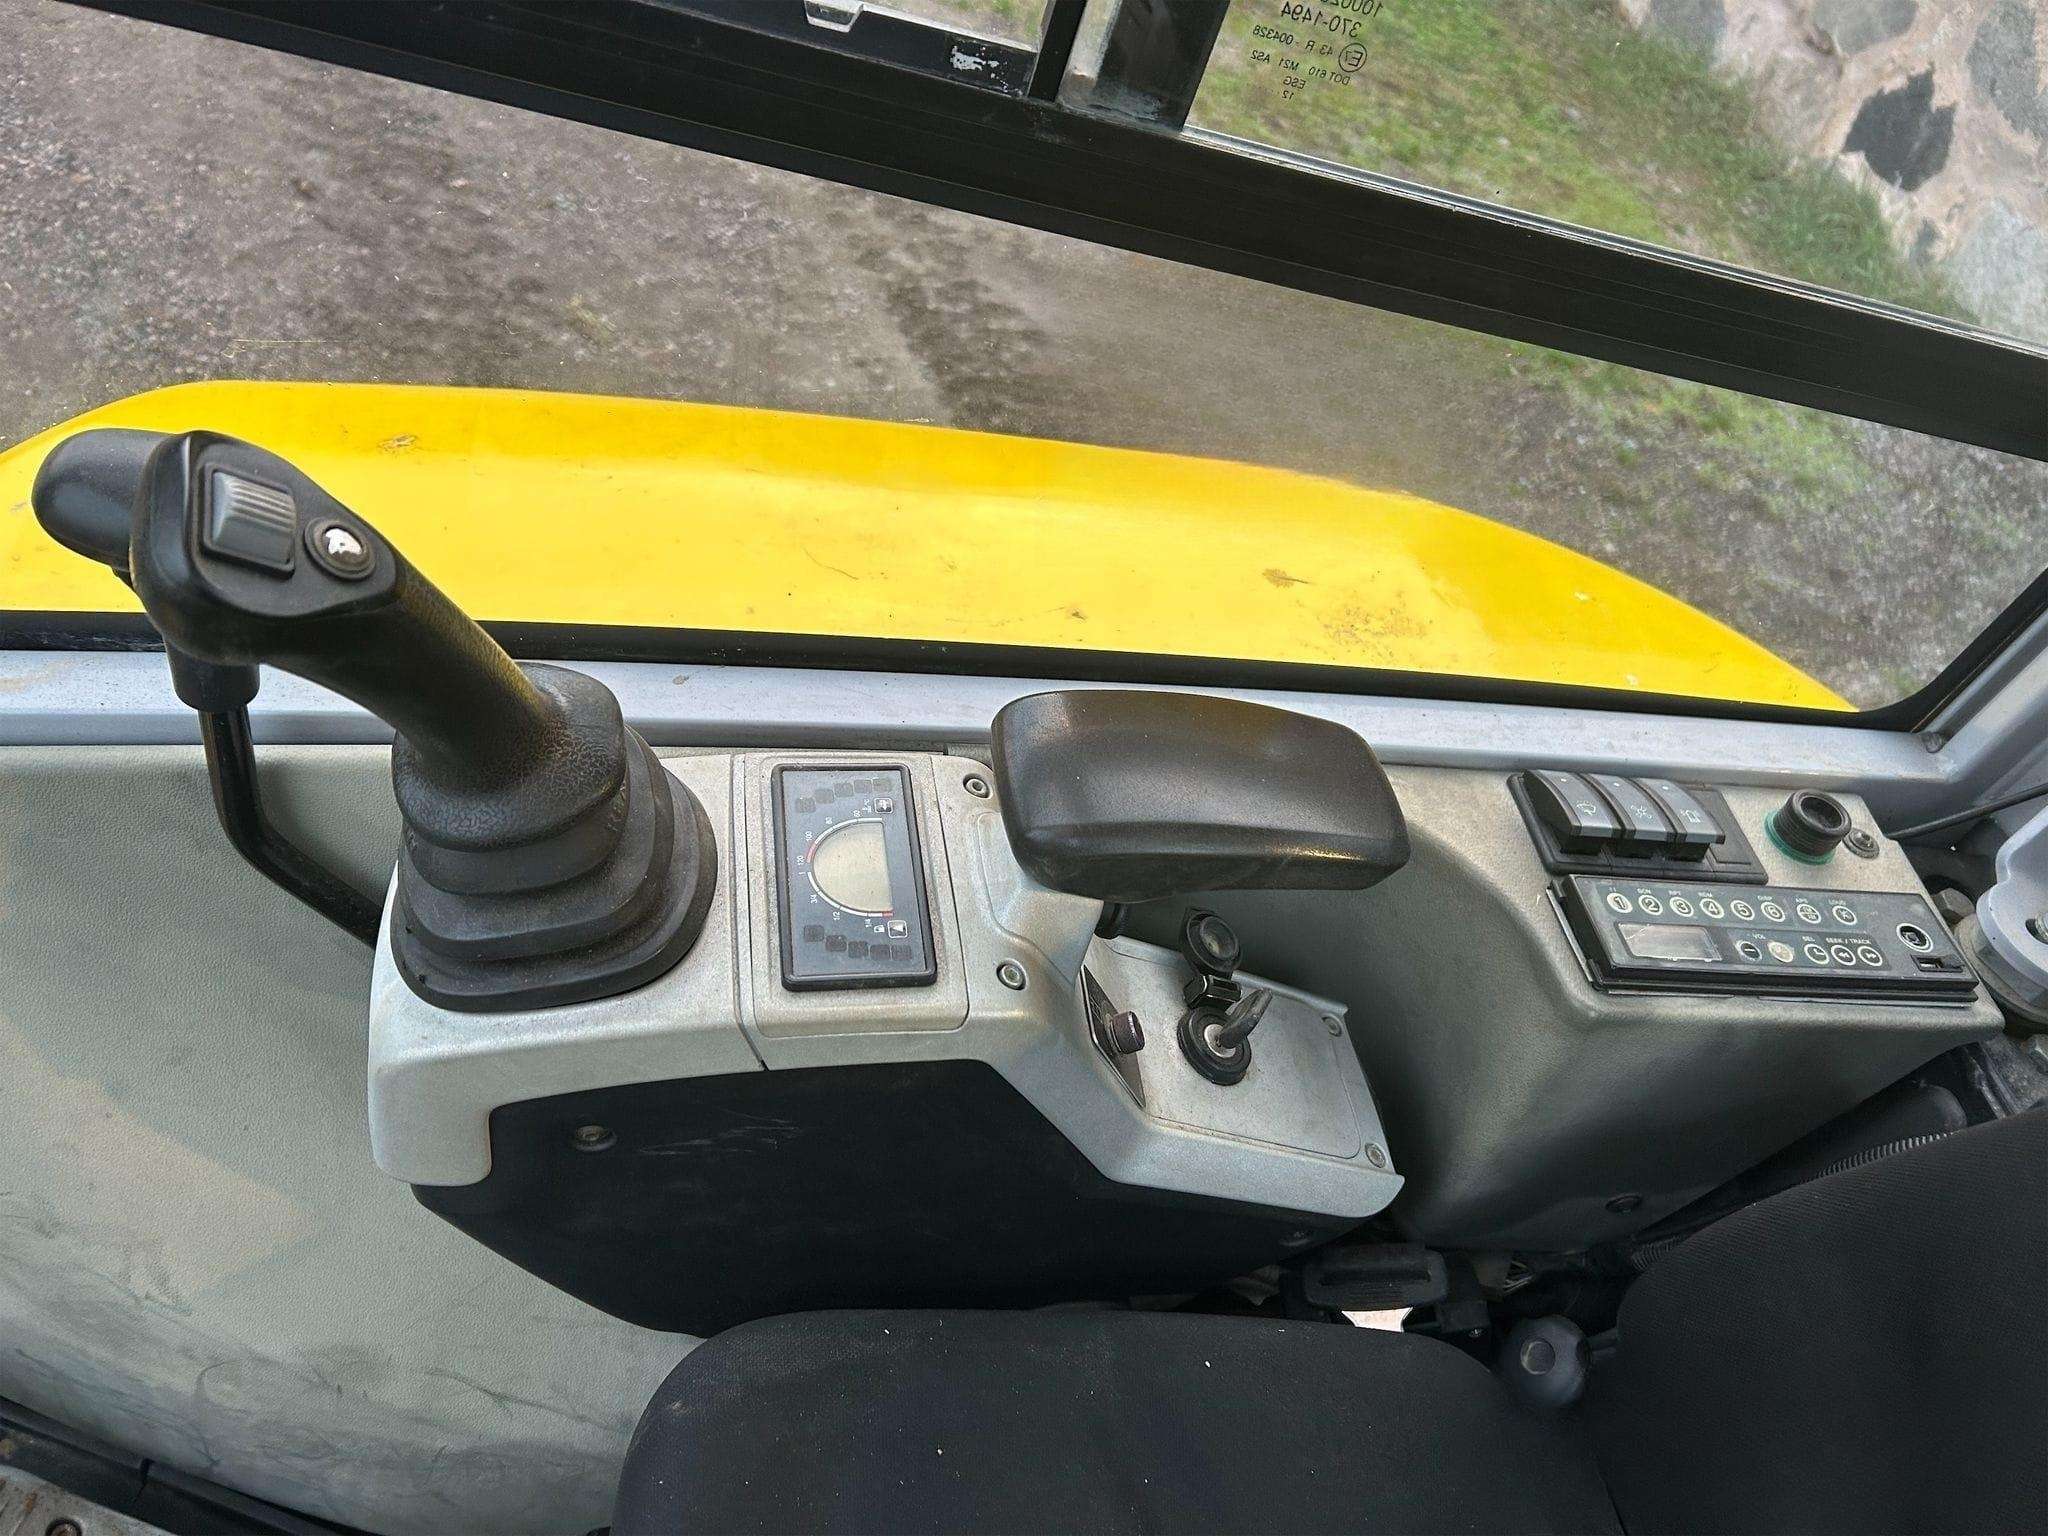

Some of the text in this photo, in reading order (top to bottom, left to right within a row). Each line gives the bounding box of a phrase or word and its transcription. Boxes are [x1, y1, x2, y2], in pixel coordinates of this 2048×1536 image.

[1646, 899, 1658, 911] 2
[1676, 900, 1688, 912] 3
[1708, 902, 1719, 914] 4
[1737, 904, 1748, 914] 5
[1768, 905, 1779, 916] 6
